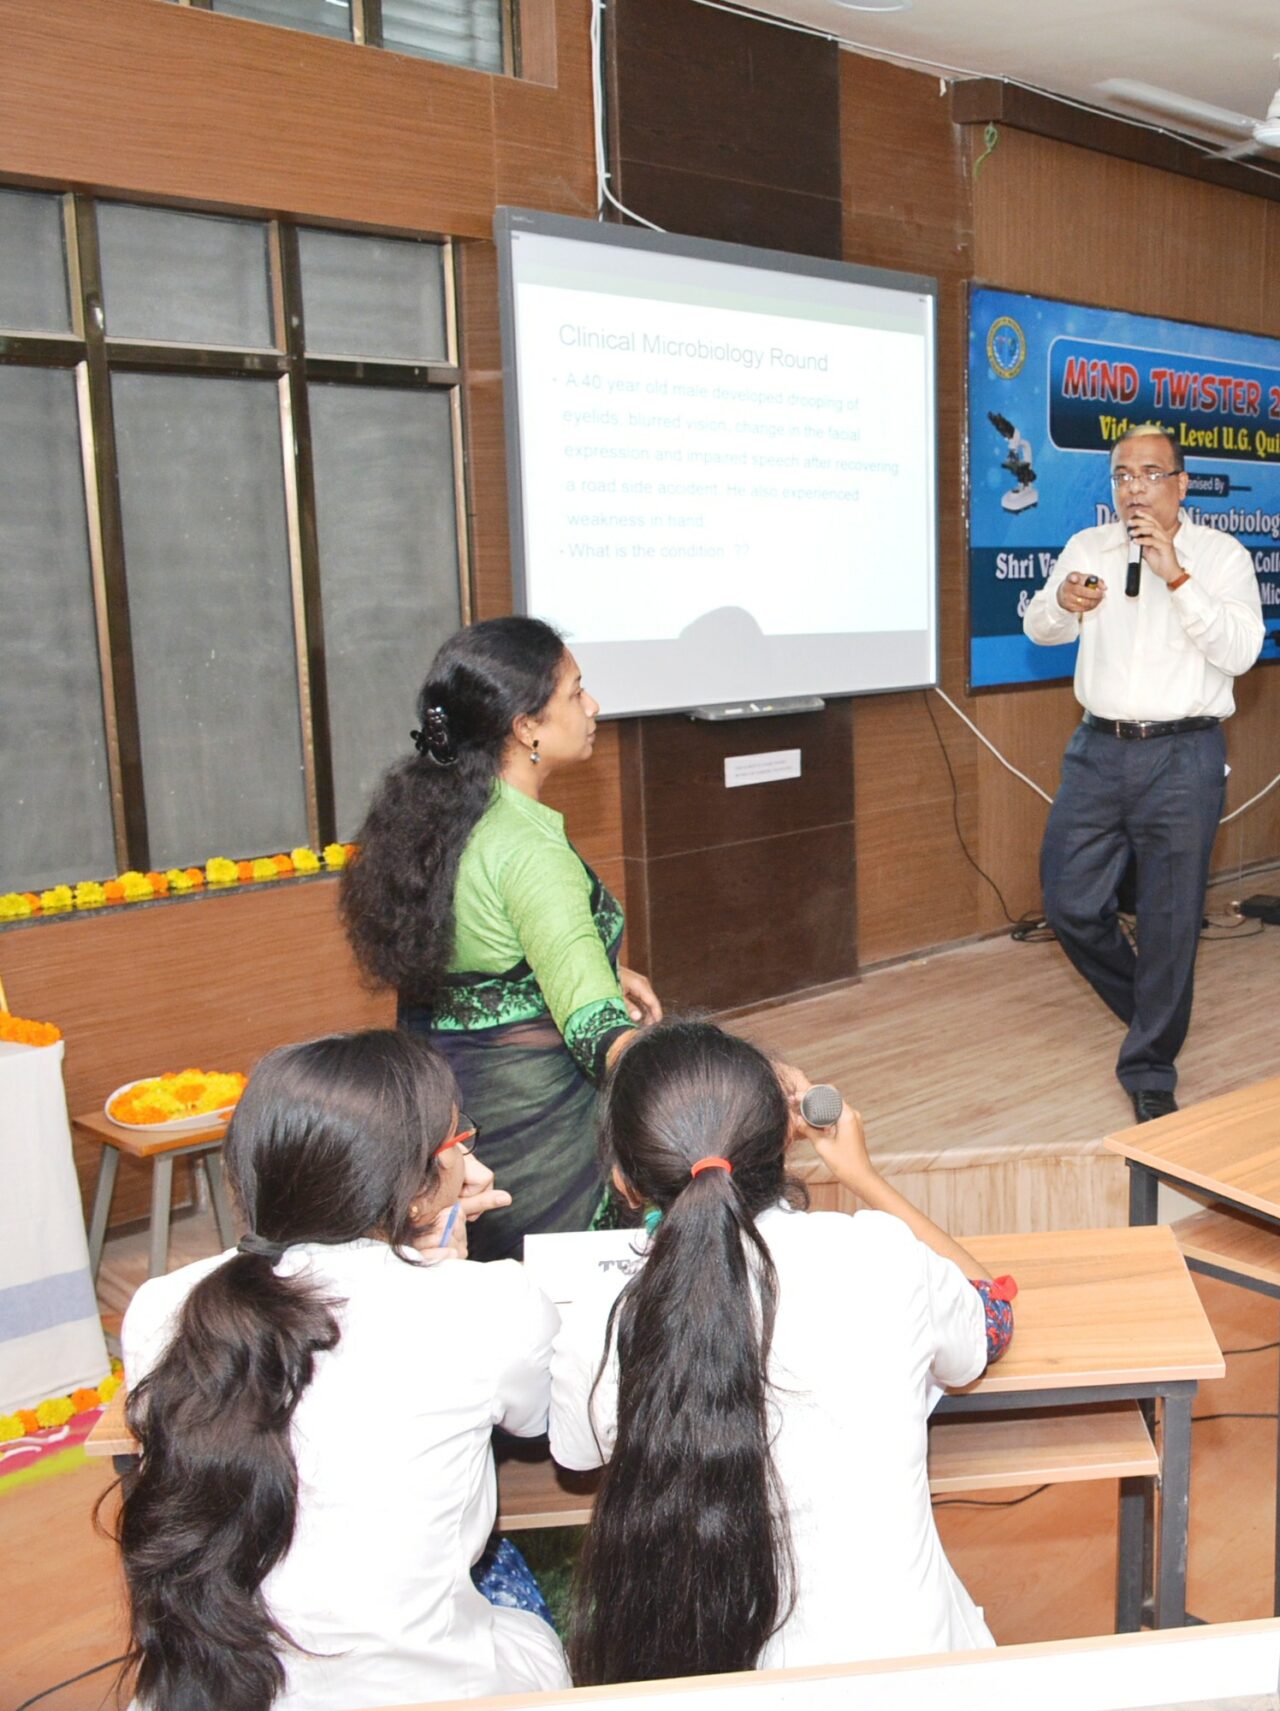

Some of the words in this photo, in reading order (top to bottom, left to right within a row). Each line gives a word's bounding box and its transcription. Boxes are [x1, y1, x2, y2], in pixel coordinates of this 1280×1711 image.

[558, 323, 635, 352] Clinical
[642, 332, 764, 370] Microbiology
[769, 347, 829, 373] Round
[565, 371, 578, 389] A
[580, 374, 602, 391] 40
[607, 378, 640, 396] year
[645, 378, 669, 396] old
[671, 381, 708, 400] male
[712, 384, 784, 407] developed
[786, 389, 843, 414] drooping
[847, 397, 861, 412] of
[627, 409, 681, 430] blurred
[735, 417, 785, 440] change
[803, 423, 825, 440] the
[827, 424, 861, 443] facial
[1179, 421, 1218, 449] Level
[1221, 425, 1252, 452] U.G.
[564, 445, 650, 463] expression
[654, 446, 683, 463] and
[686, 448, 748, 467] impaired
[751, 453, 800, 470] speech
[803, 455, 832, 471] after
[835, 457, 899, 478] recovering
[580, 477, 617, 495] road
[620, 479, 653, 495] side
[727, 483, 746, 498] He
[750, 484, 778, 499] also
[782, 486, 861, 504] experienced
[1214, 477, 1225, 495] By
[566, 511, 646, 528] weakness
[650, 512, 663, 528] in
[568, 542, 611, 560] What
[614, 543, 628, 560] is
[632, 542, 657, 560] the
[995, 552, 1035, 580] Shri
